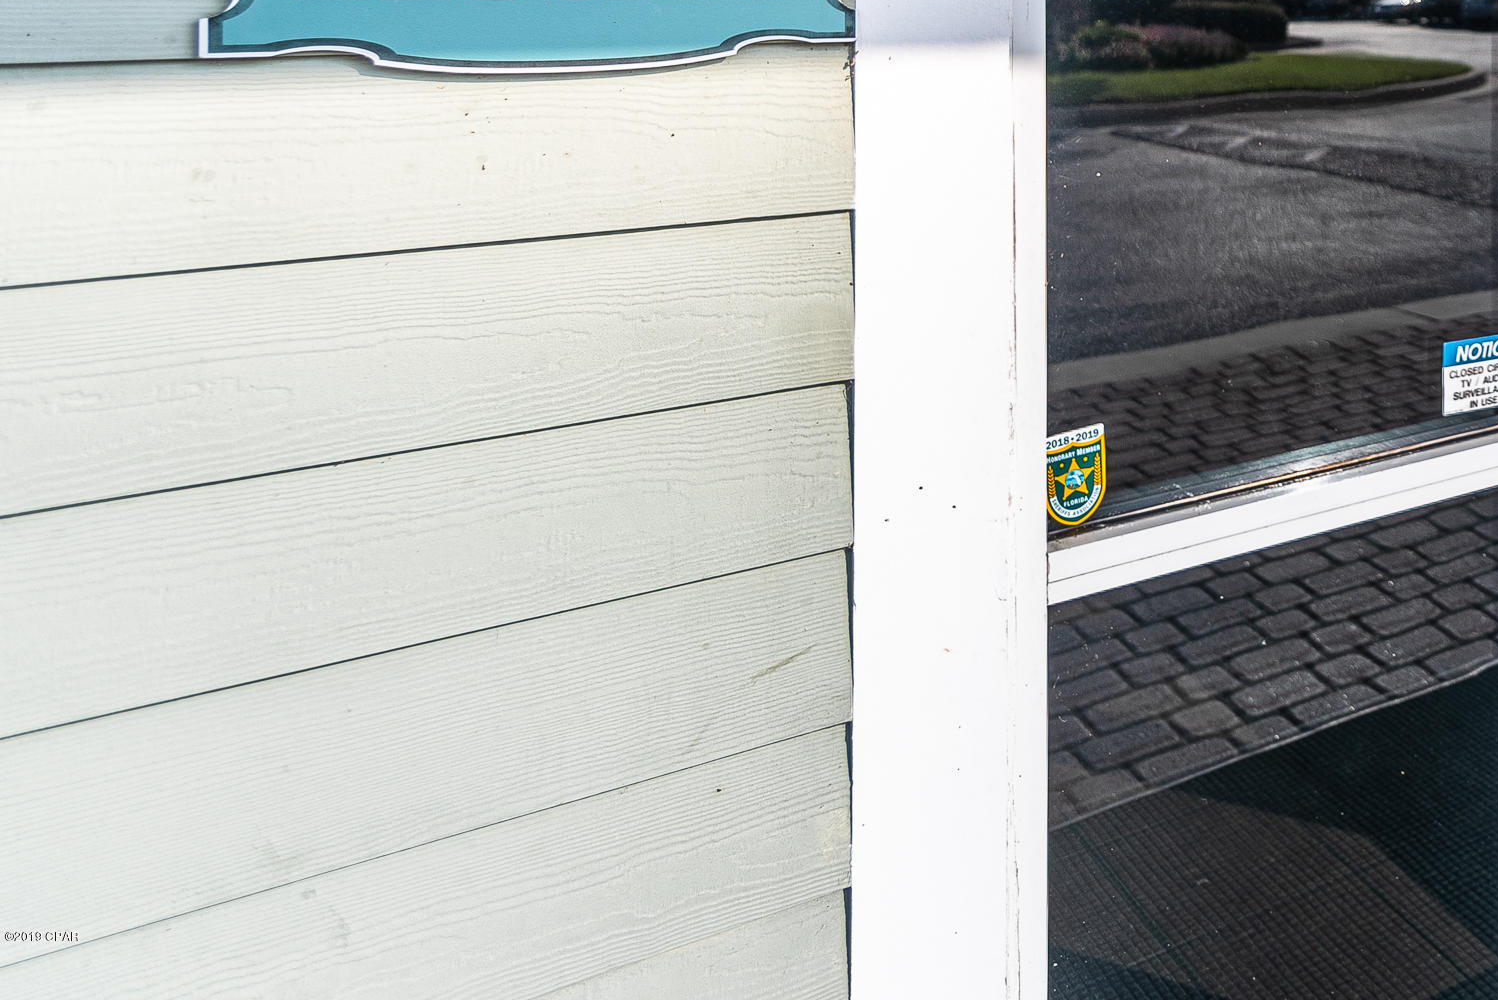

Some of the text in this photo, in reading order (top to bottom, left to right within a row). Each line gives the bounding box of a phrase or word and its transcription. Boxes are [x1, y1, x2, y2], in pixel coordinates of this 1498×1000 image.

[1449, 366, 1484, 379] CLOSED
[1461, 379, 1472, 388] TV
[1470, 396, 1498, 408] IN USE
[1063, 495, 1088, 507] FLORIDA
